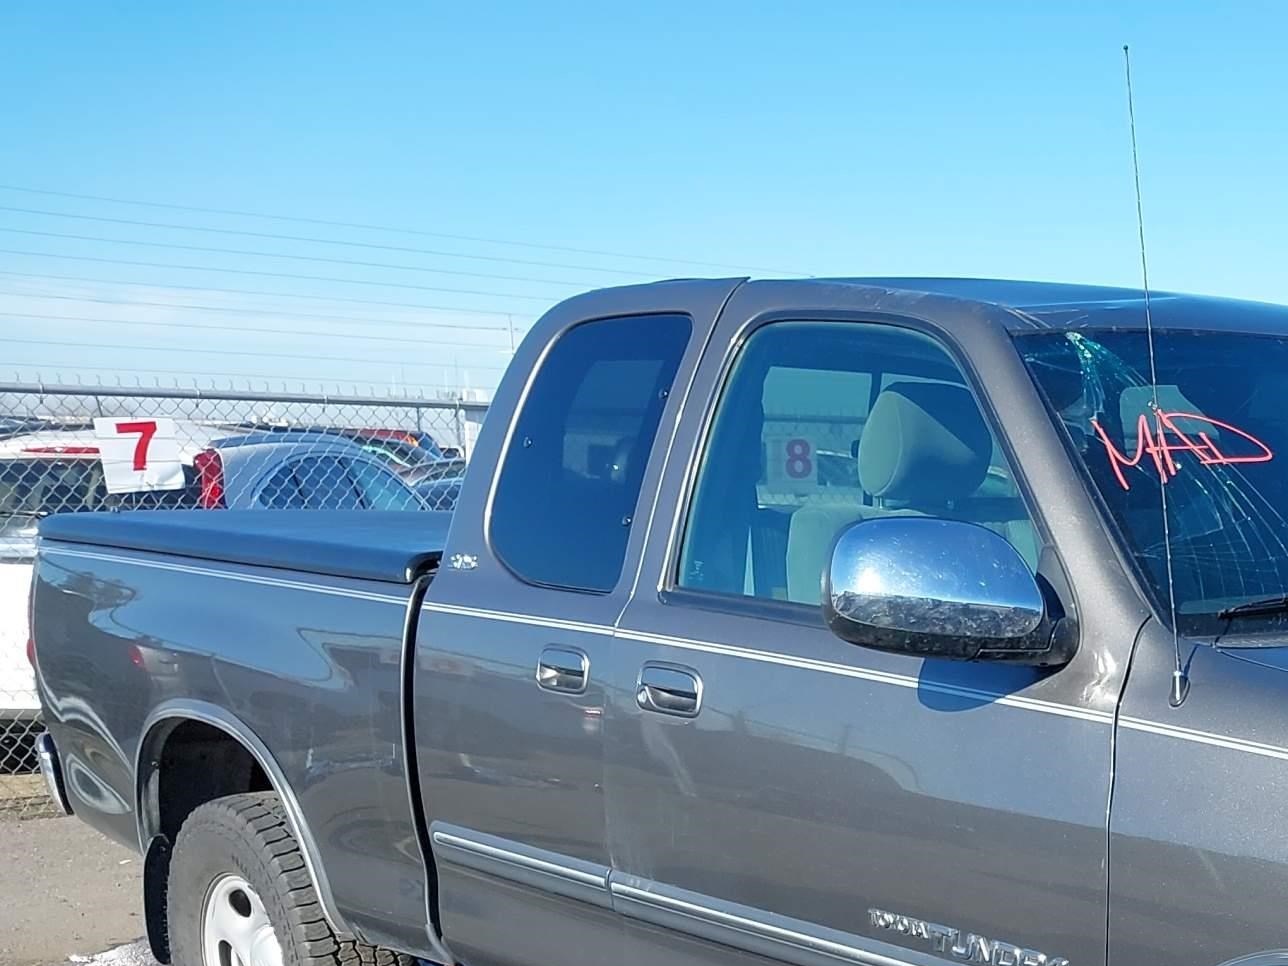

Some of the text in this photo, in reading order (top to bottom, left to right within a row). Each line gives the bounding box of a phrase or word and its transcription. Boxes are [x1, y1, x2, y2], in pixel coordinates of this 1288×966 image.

[115, 420, 157, 471] 7
[784, 437, 813, 480] 8
[1090, 409, 1273, 491] MAD
